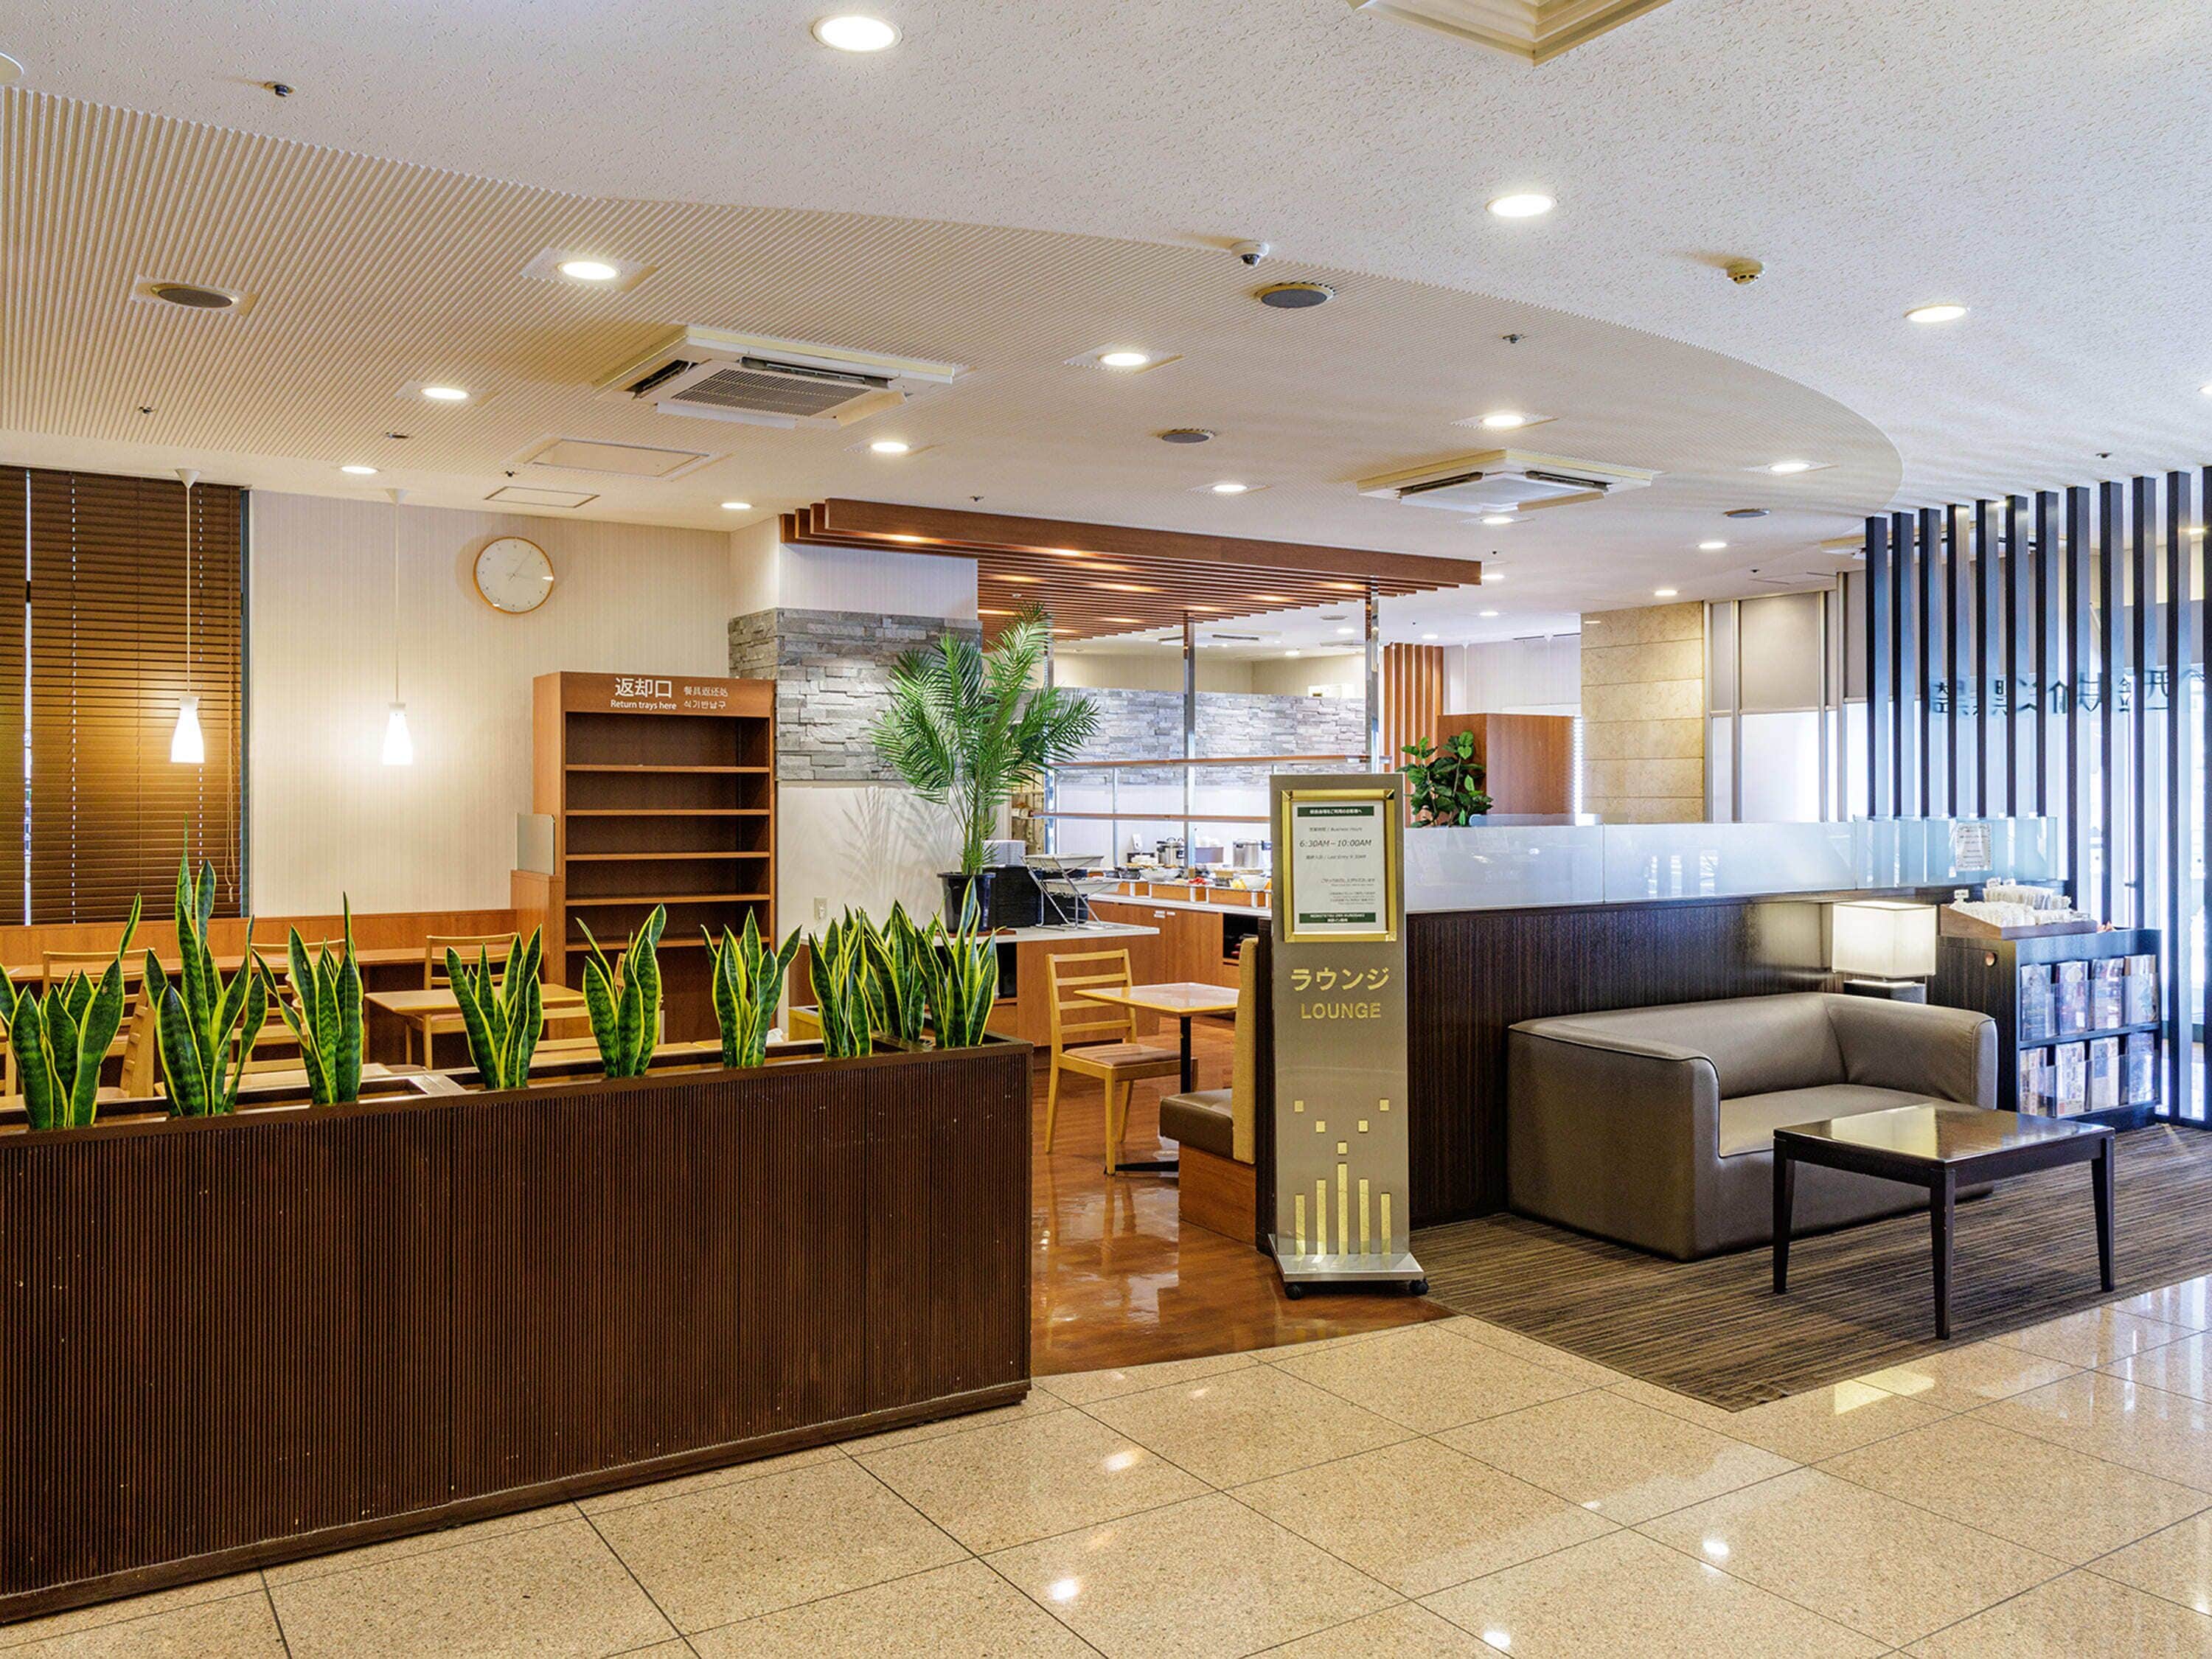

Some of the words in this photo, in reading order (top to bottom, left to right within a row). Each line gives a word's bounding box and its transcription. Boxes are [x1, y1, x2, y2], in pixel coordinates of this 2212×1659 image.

[615, 678, 672, 698] 返却口
[611, 700, 637, 709] Return
[639, 701, 658, 711] trays
[659, 701, 677, 710] here
[1291, 967, 1389, 992] ラウンジ
[1300, 1002, 1381, 1019] LOUNGE
